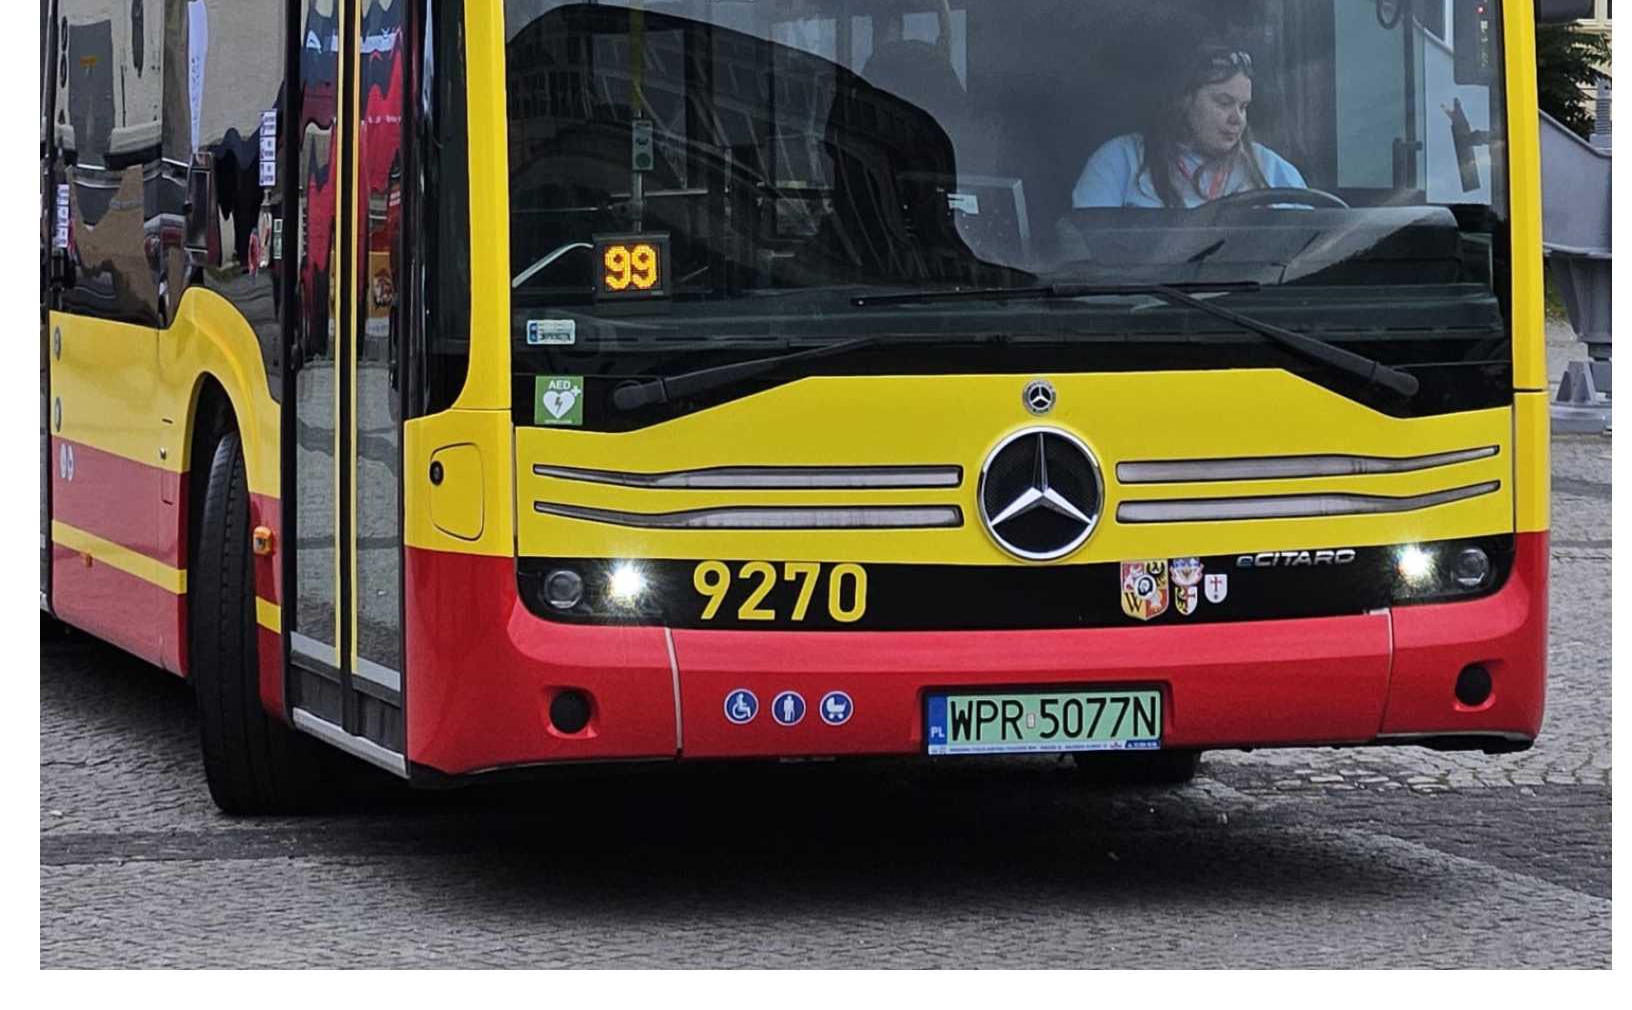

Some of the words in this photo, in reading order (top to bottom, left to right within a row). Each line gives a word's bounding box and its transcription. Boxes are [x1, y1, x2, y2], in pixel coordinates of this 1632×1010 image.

[604, 244, 658, 290] 99
[548, 380, 571, 390] AED
[693, 560, 868, 623] 9270
[930, 726, 945, 738] PL
[951, 699, 1023, 741] WPR
[1039, 696, 1157, 739] 5077N
